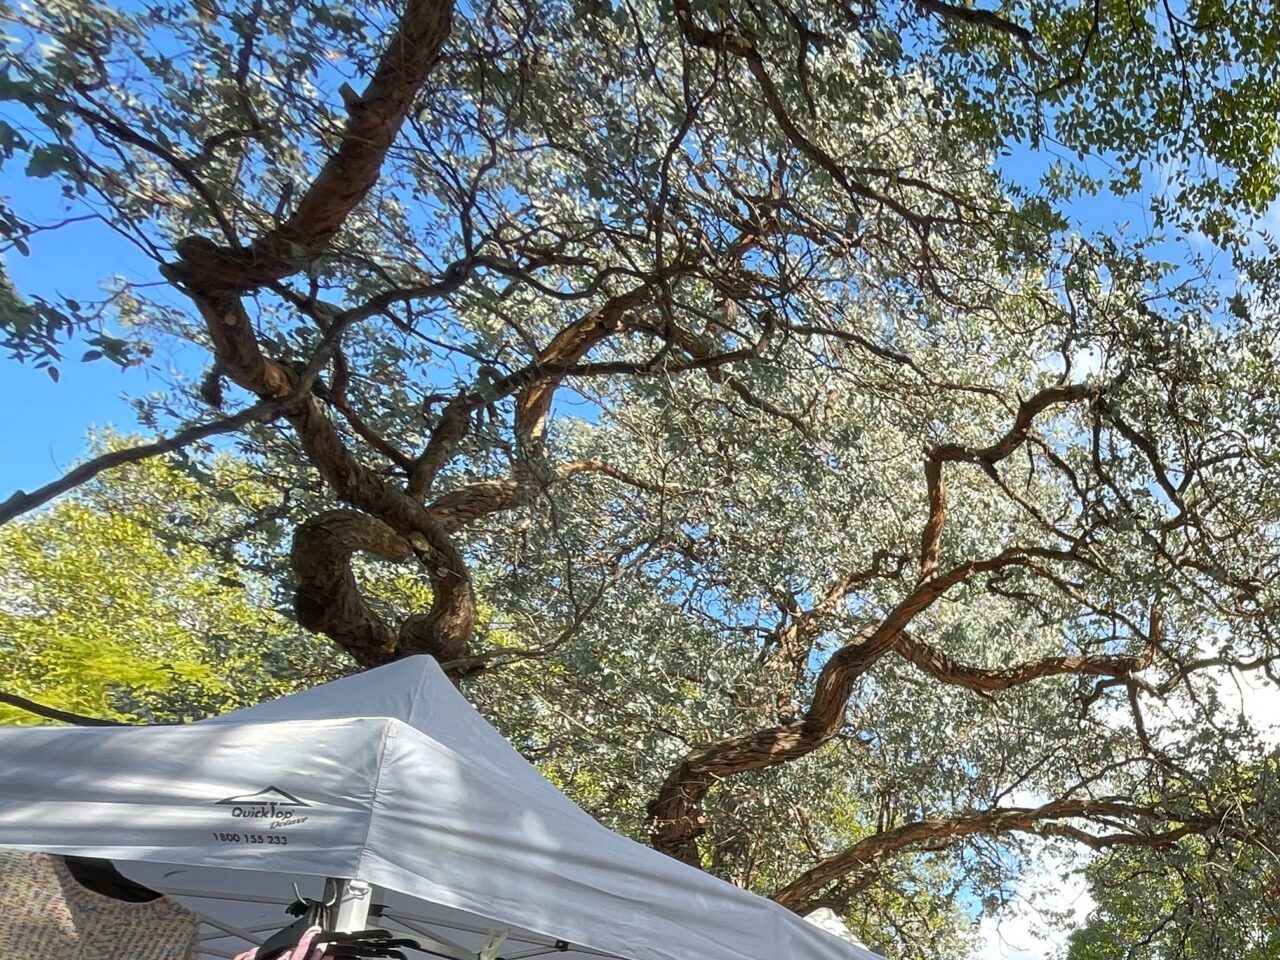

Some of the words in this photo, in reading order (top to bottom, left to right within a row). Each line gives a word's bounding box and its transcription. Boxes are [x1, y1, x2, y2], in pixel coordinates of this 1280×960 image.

[231, 801, 294, 820] QuickTop
[213, 832, 240, 843] 1800
[243, 834, 264, 844] 155
[267, 835, 288, 846] 233
